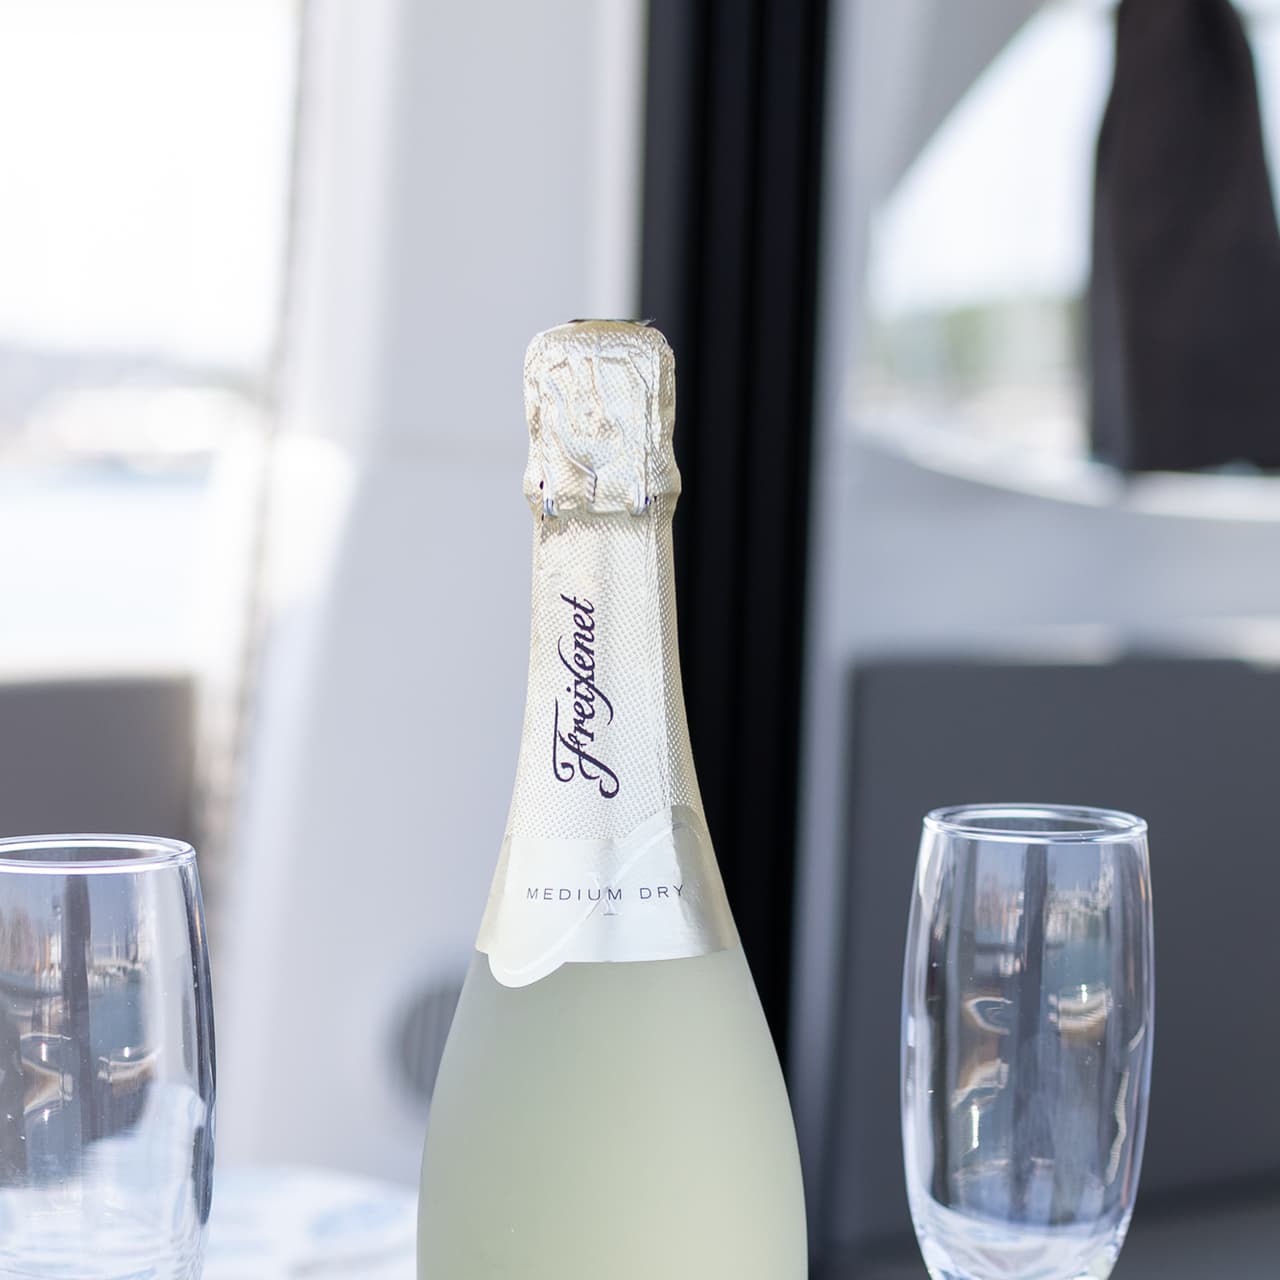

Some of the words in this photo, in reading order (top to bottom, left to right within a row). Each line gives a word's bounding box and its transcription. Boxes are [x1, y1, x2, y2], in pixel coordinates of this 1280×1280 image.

[553, 593, 620, 799] Freixenet
[526, 887, 622, 901] MEDIUM
[639, 884, 684, 900] DRY
